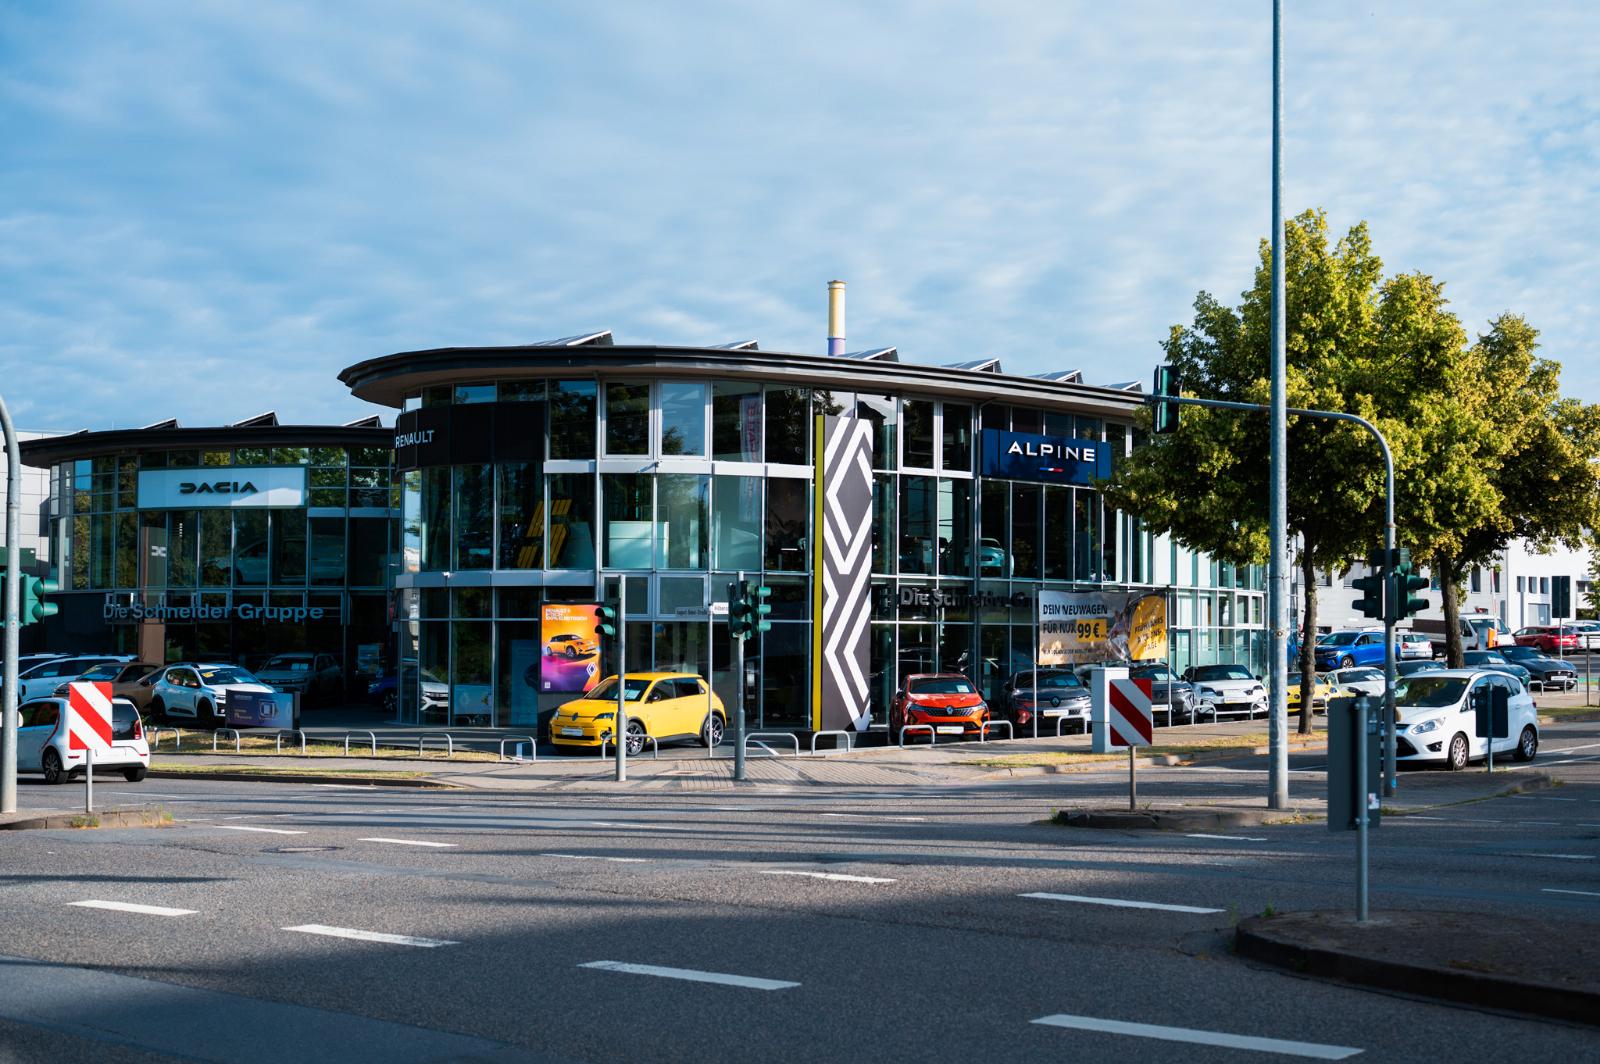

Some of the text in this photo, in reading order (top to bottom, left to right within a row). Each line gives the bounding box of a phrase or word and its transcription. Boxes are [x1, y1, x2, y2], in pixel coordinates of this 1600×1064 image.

[395, 429, 435, 449] RENAULT
[1007, 440, 1095, 462] ALPINE
[179, 481, 258, 494] DACIA
[900, 586, 930, 606] Die
[103, 603, 324, 623] Die Schneider Gruppe
[1042, 604, 1108, 616] DEIN NEUWAGEN
[1042, 621, 1077, 634] FÜR NUR
[1077, 622, 1092, 639] 99
